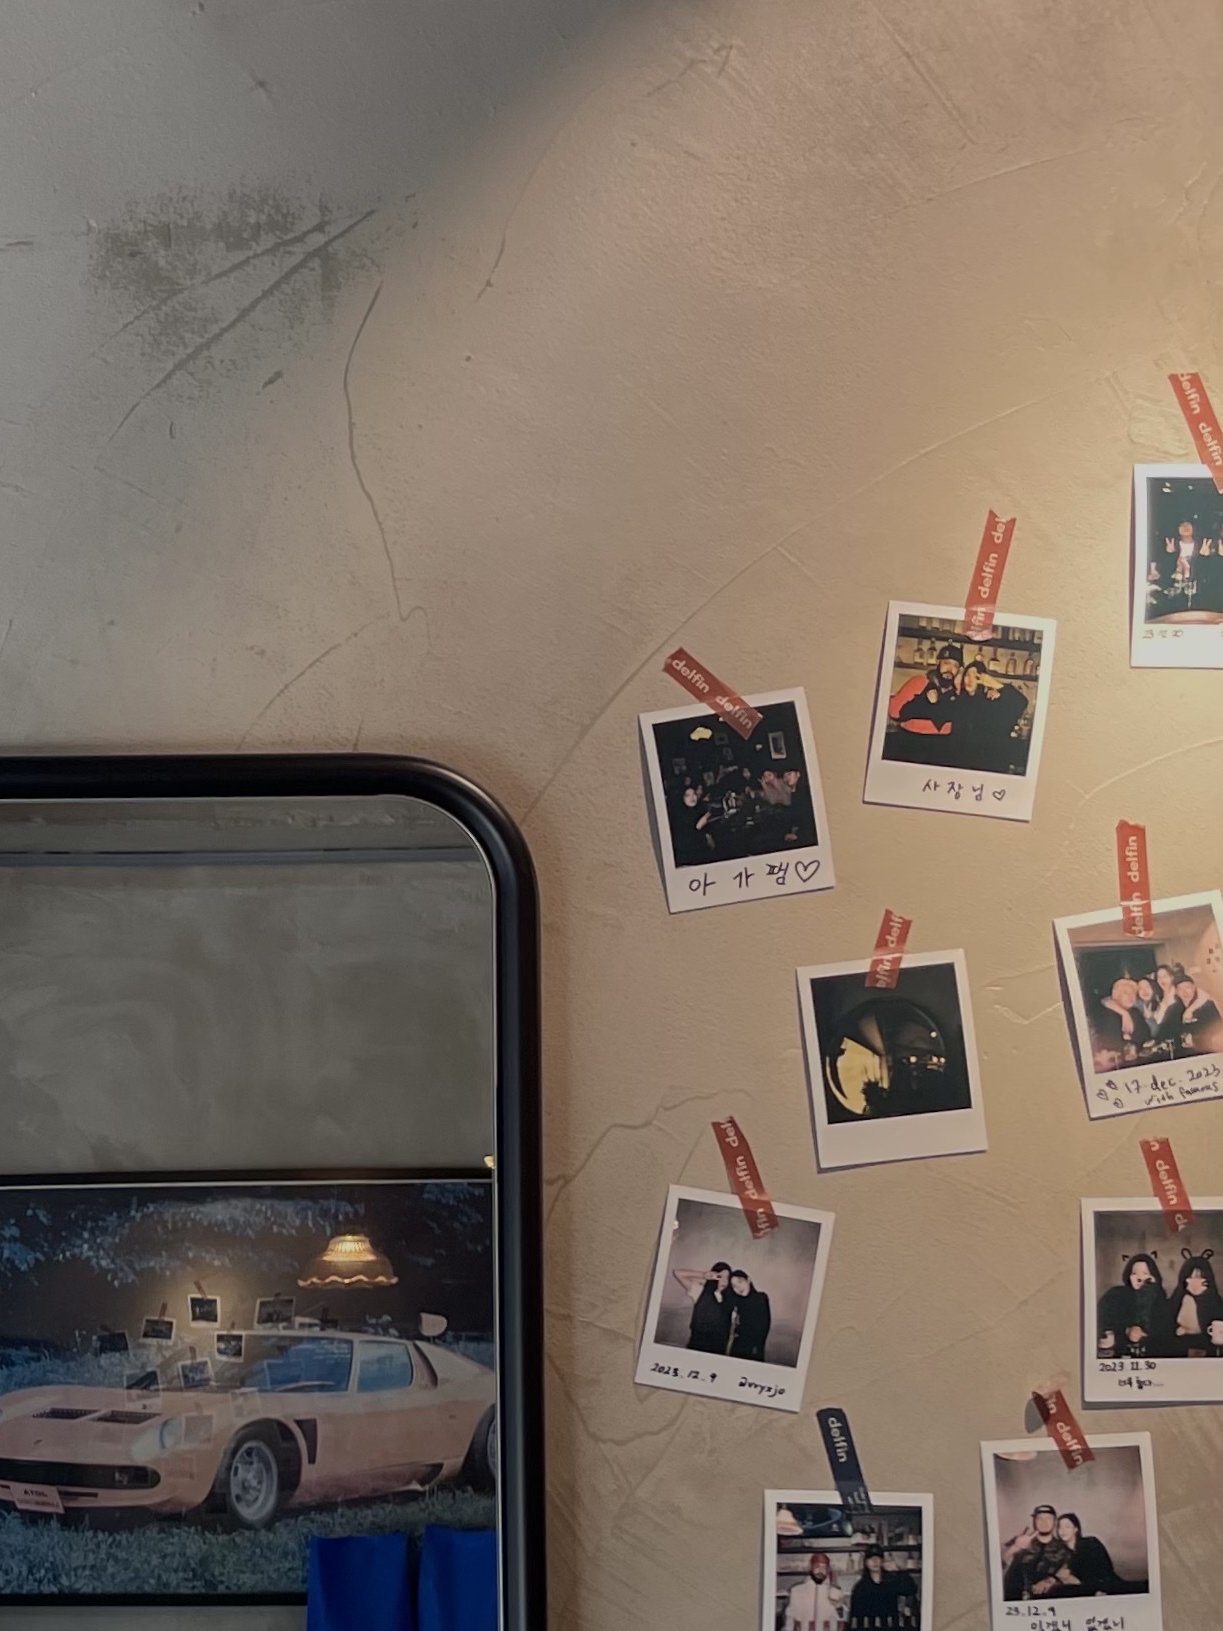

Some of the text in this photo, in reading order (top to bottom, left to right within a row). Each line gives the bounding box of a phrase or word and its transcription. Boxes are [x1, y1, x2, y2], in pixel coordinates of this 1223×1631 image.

[1198, 422, 1223, 466] delfin
[978, 552, 998, 599] delfin
[672, 657, 753, 730] delfin delfin
[1124, 835, 1145, 937] delfin delfin
[736, 1155, 760, 1200] delfin
[1156, 1159, 1178, 1205] delfin
[828, 1417, 849, 1463] delfin
[1056, 1422, 1083, 1465] delfin
